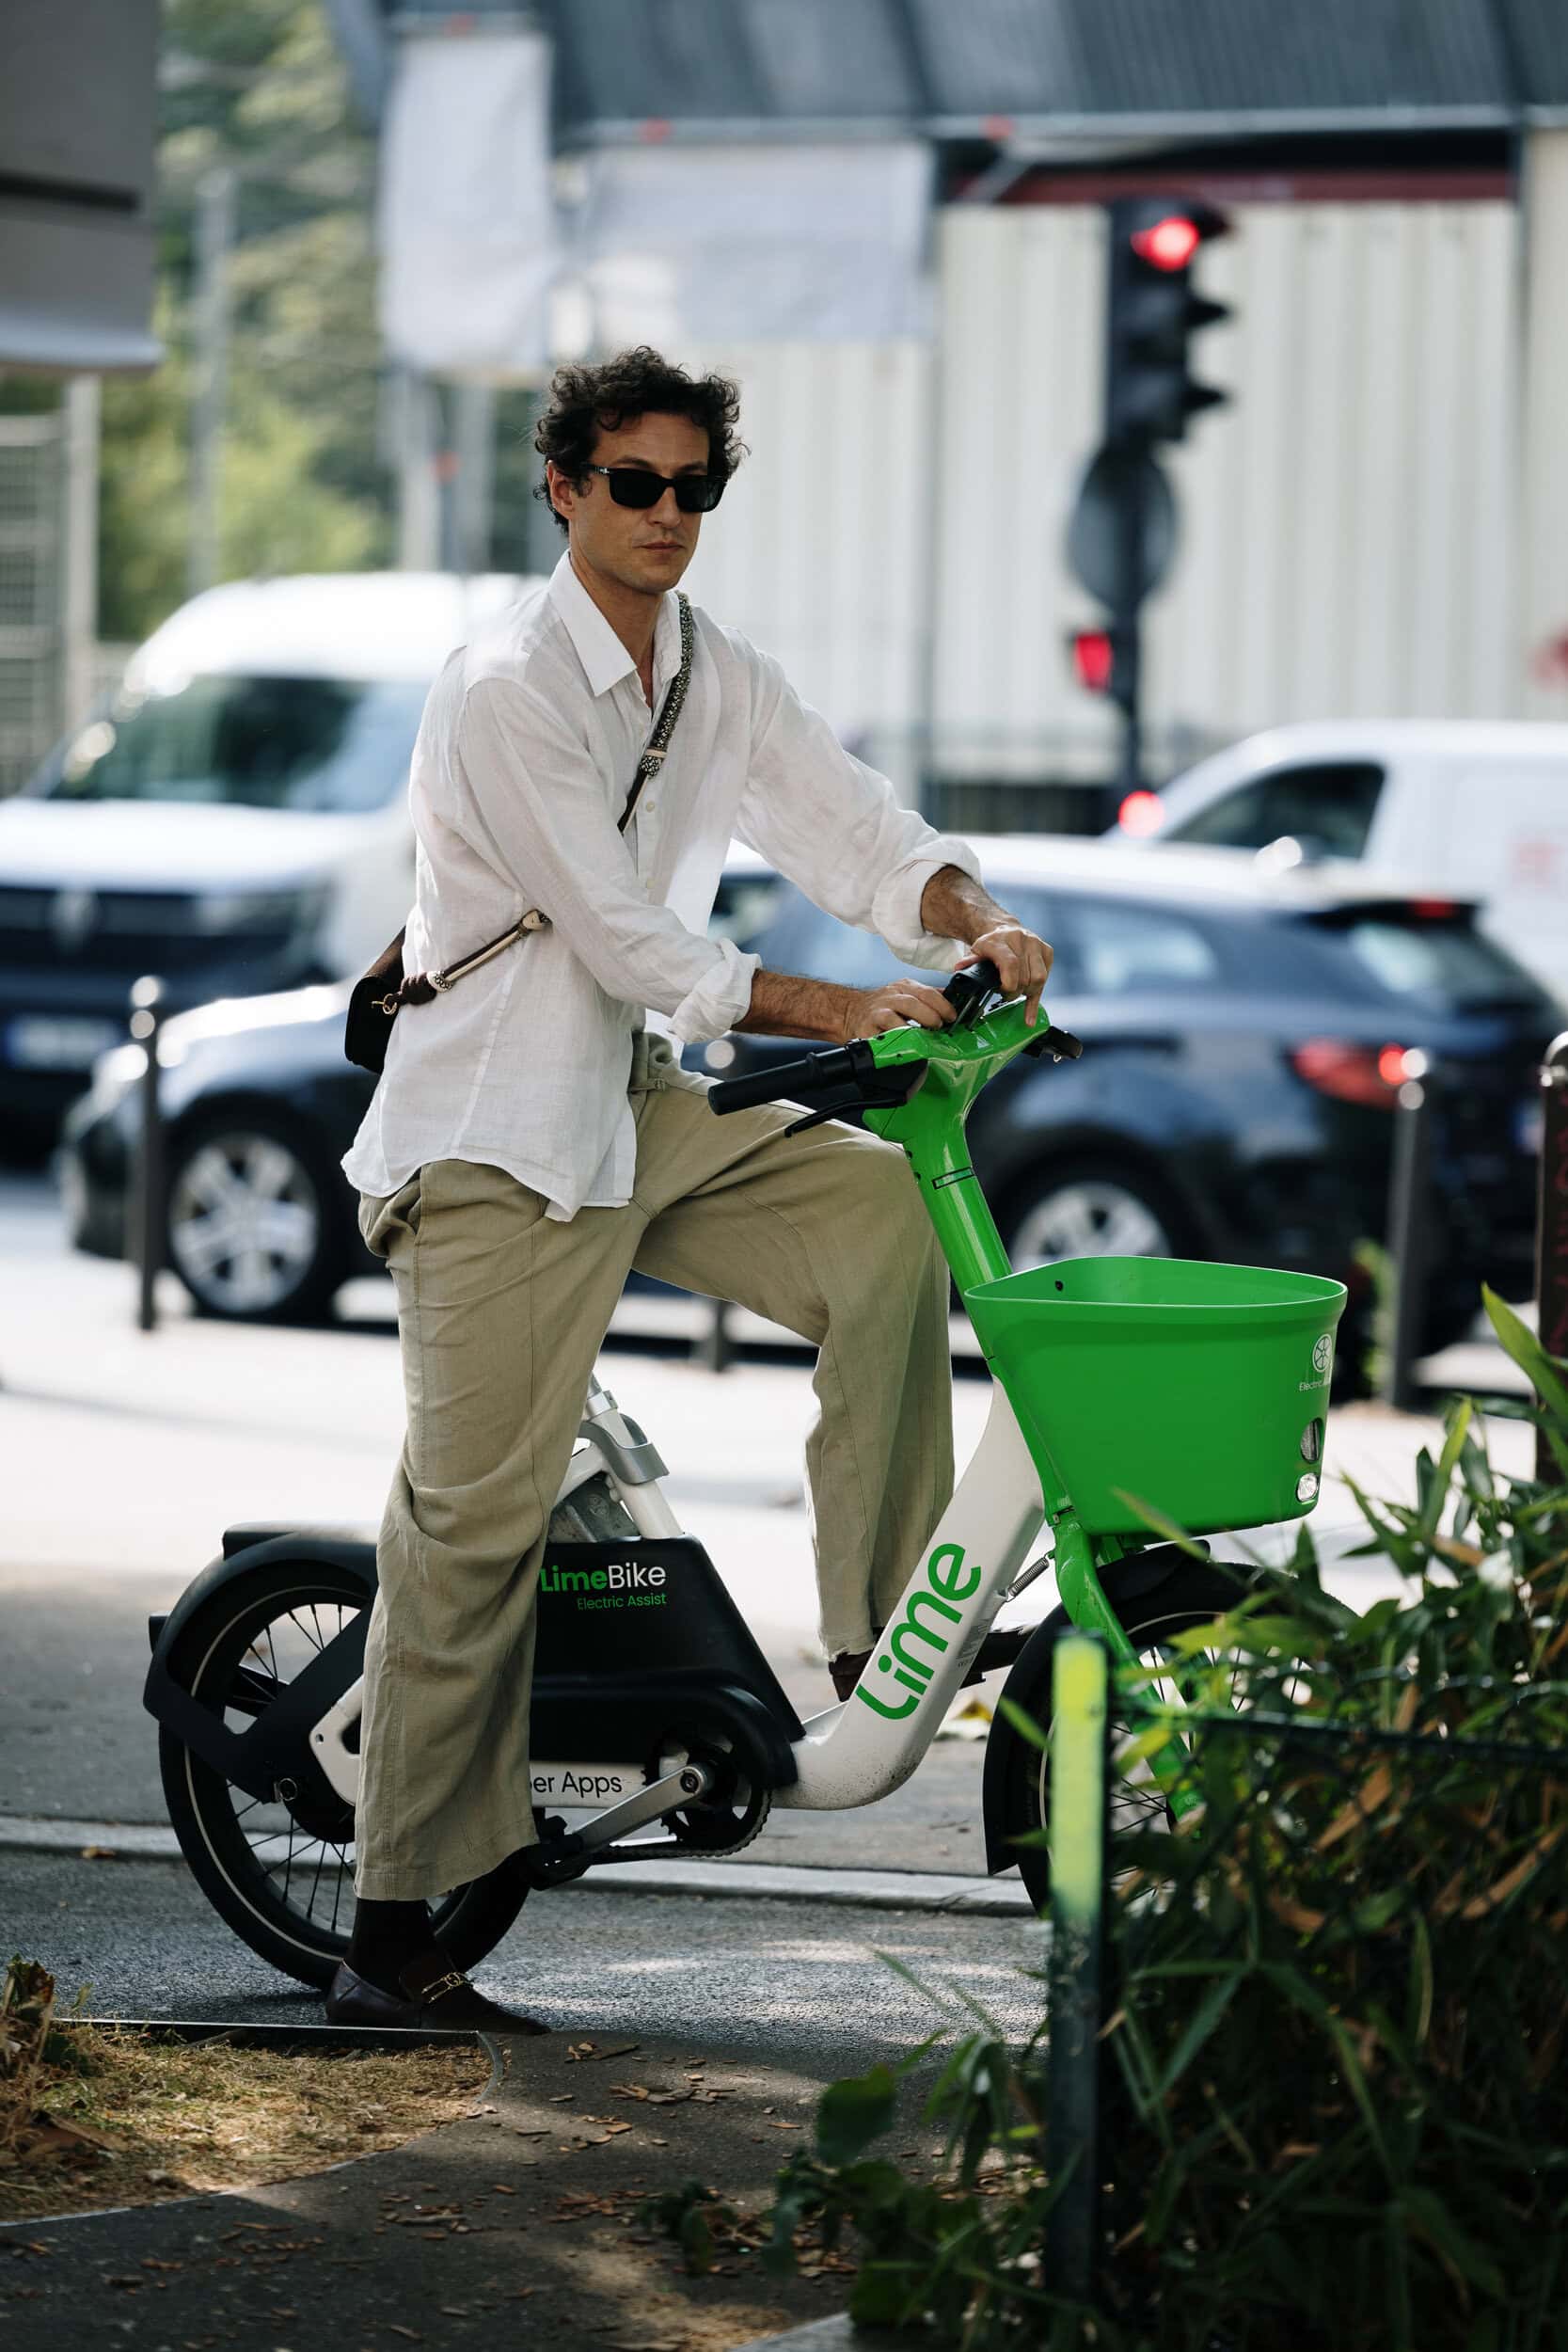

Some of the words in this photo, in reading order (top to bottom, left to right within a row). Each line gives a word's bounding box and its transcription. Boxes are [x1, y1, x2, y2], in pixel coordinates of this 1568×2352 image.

[540, 1562, 667, 1593] LimeBike
[577, 1595, 625, 1611] Electric
[627, 1592, 667, 1607] Assist
[855, 1543, 982, 1720] Lime
[530, 1776, 555, 1793] er
[562, 1771, 623, 1798] Apps
